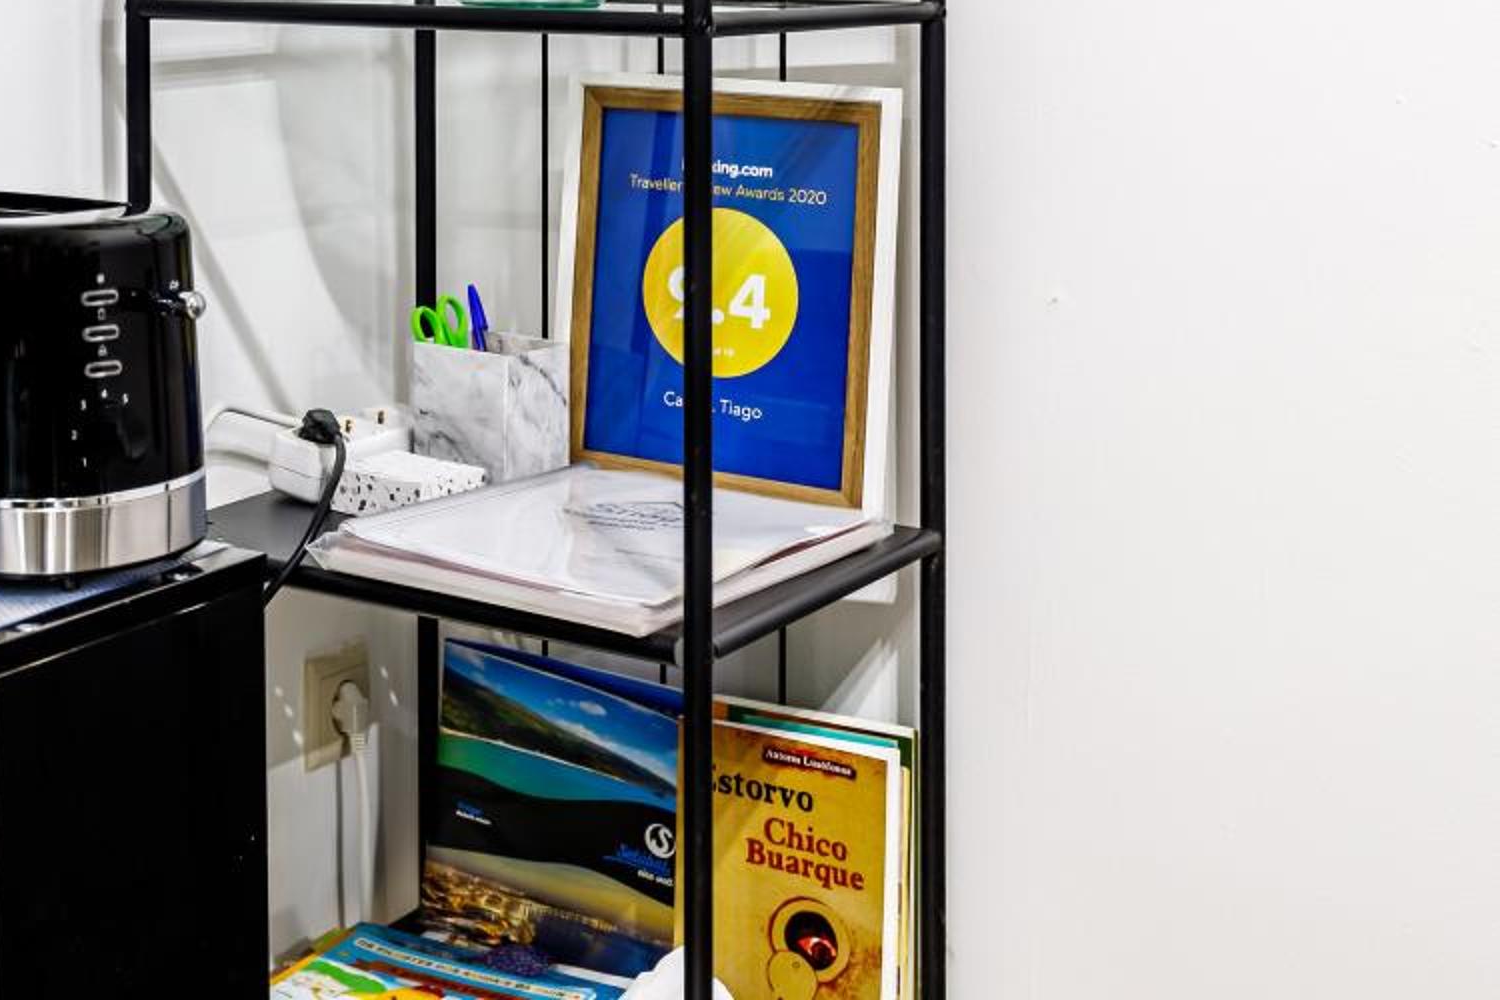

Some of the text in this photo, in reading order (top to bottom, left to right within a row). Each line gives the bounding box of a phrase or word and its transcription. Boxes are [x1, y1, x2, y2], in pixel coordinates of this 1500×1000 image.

[735, 184, 786, 202] Awards
[788, 188, 827, 206] 2020
[719, 398, 763, 422] Tiago
[764, 817, 848, 861] Chico
[745, 837, 865, 891] Buarque
